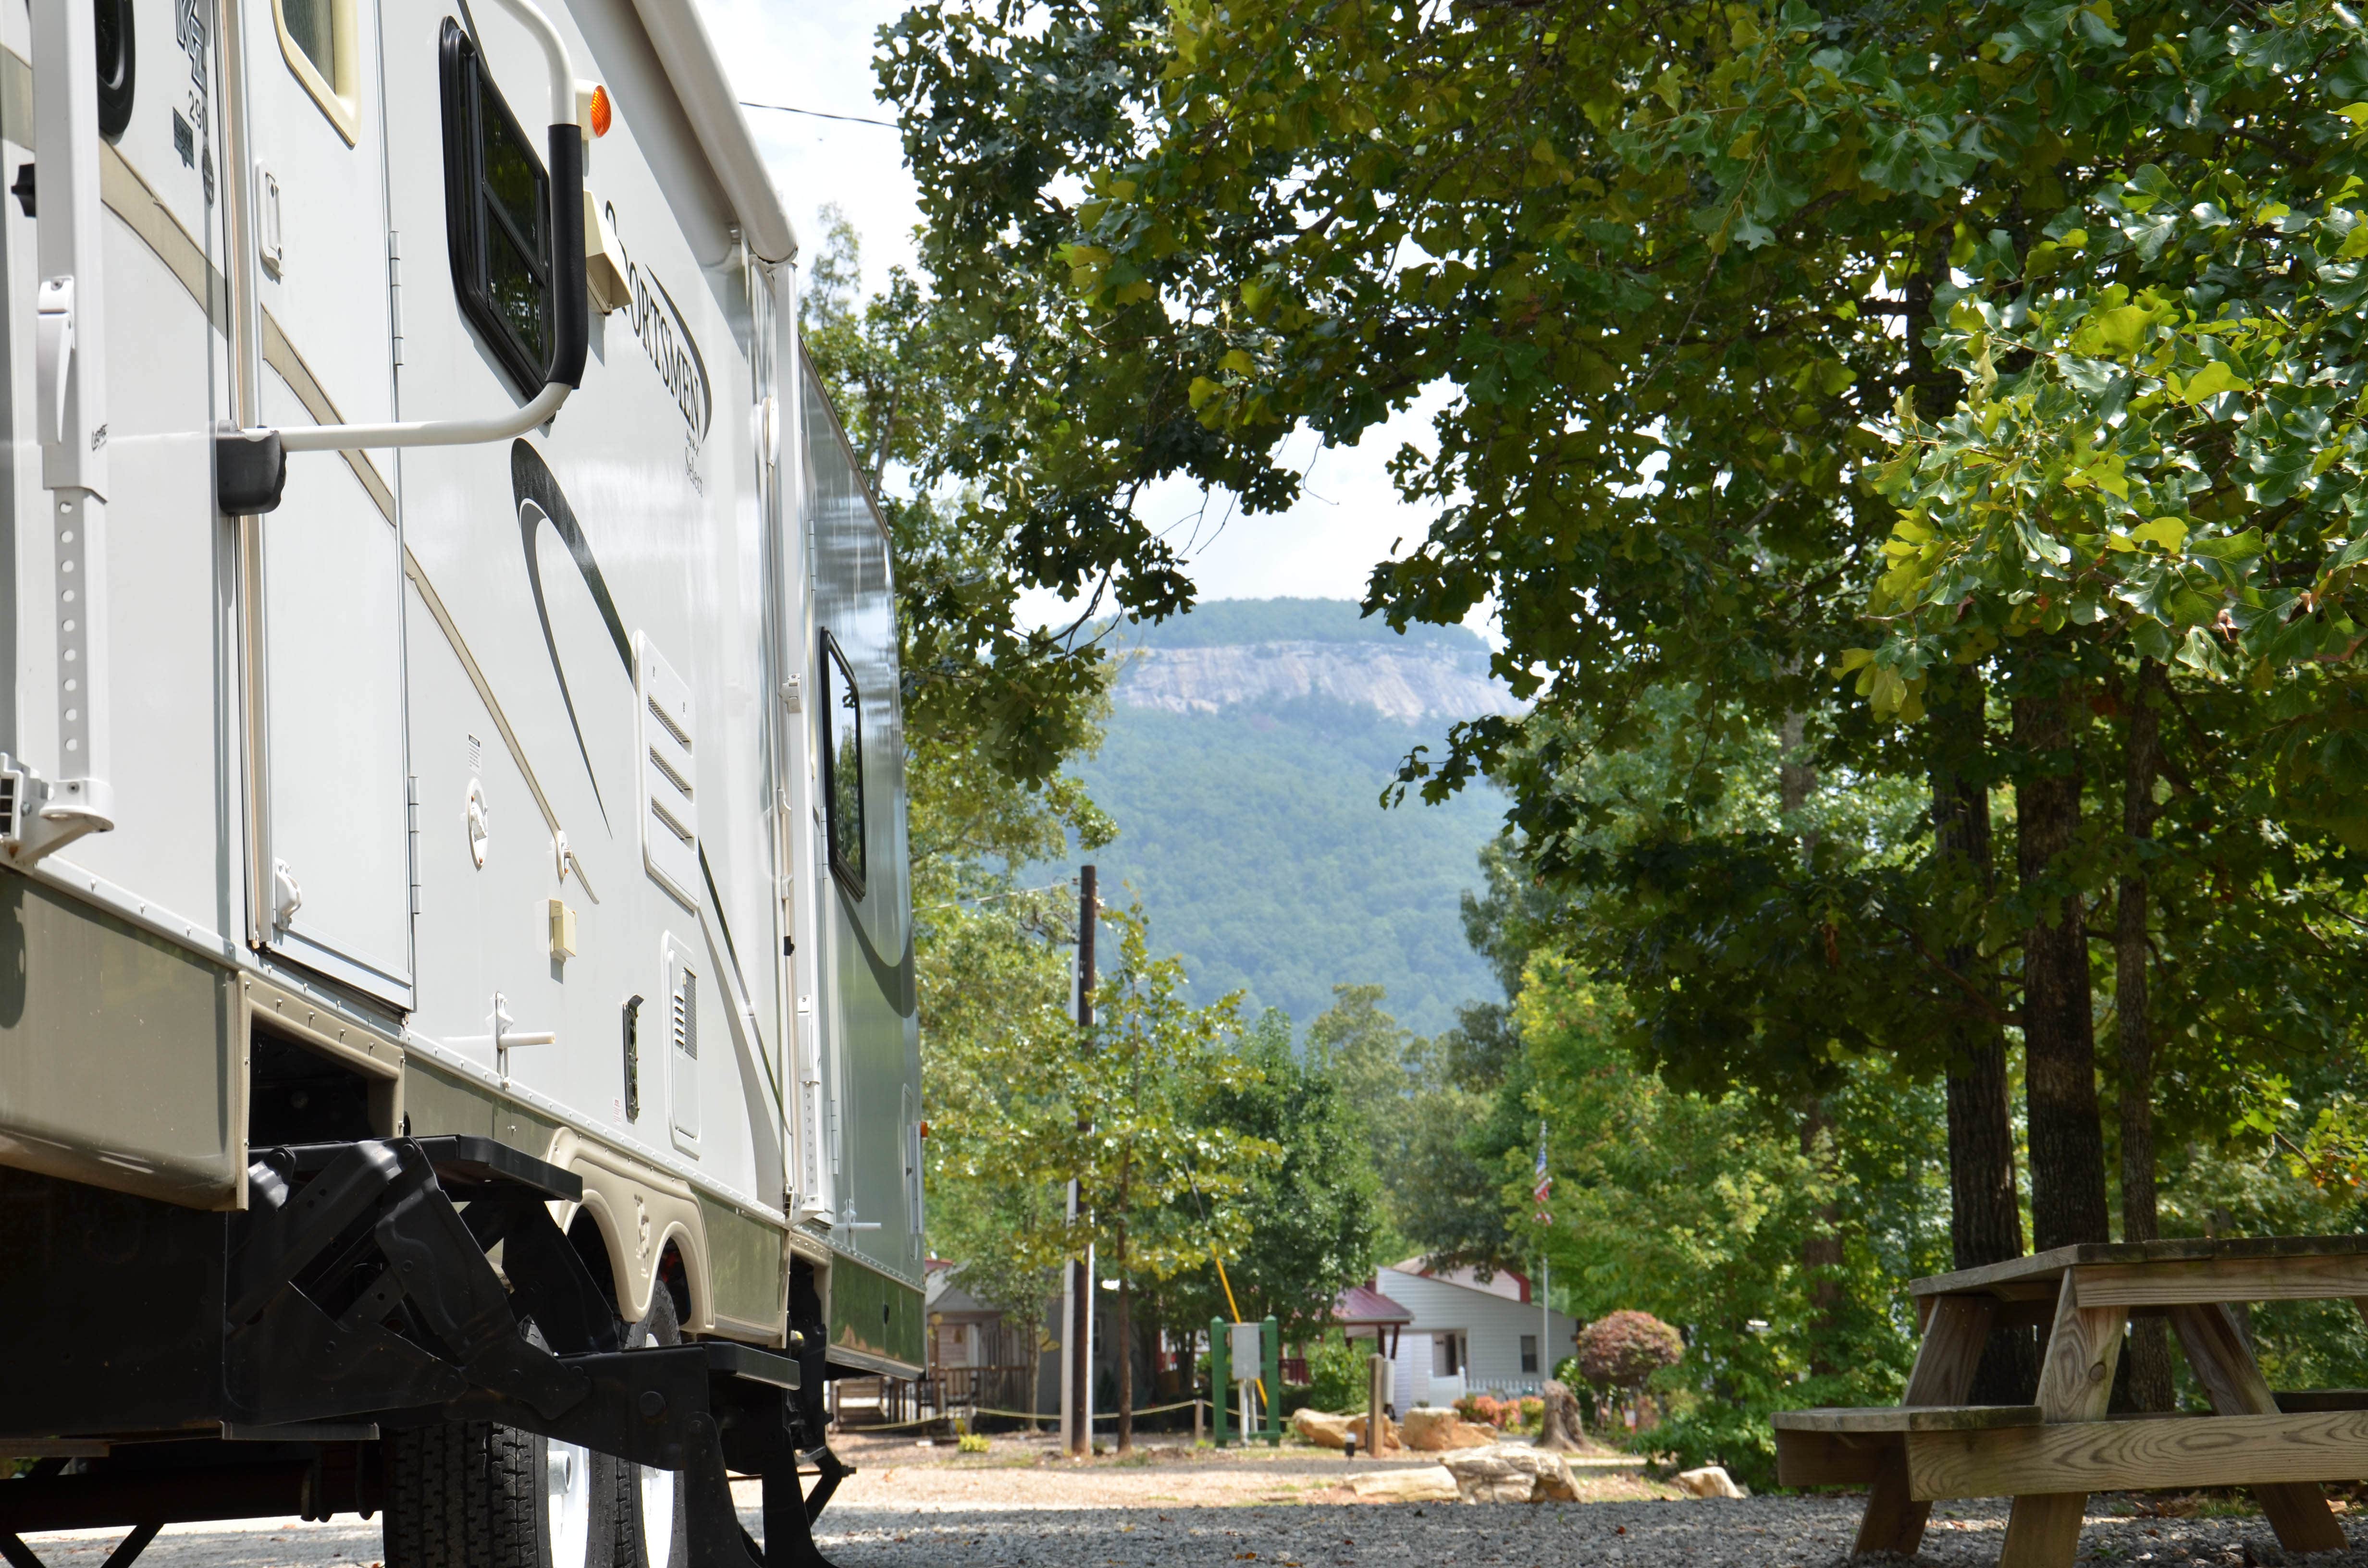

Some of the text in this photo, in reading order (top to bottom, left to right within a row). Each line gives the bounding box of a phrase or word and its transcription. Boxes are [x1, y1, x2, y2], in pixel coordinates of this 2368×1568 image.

[188, 89, 208, 138] 290
[605, 200, 702, 445] ORTSMEN
[686, 429, 692, 448] by
[685, 447, 703, 498] Select
